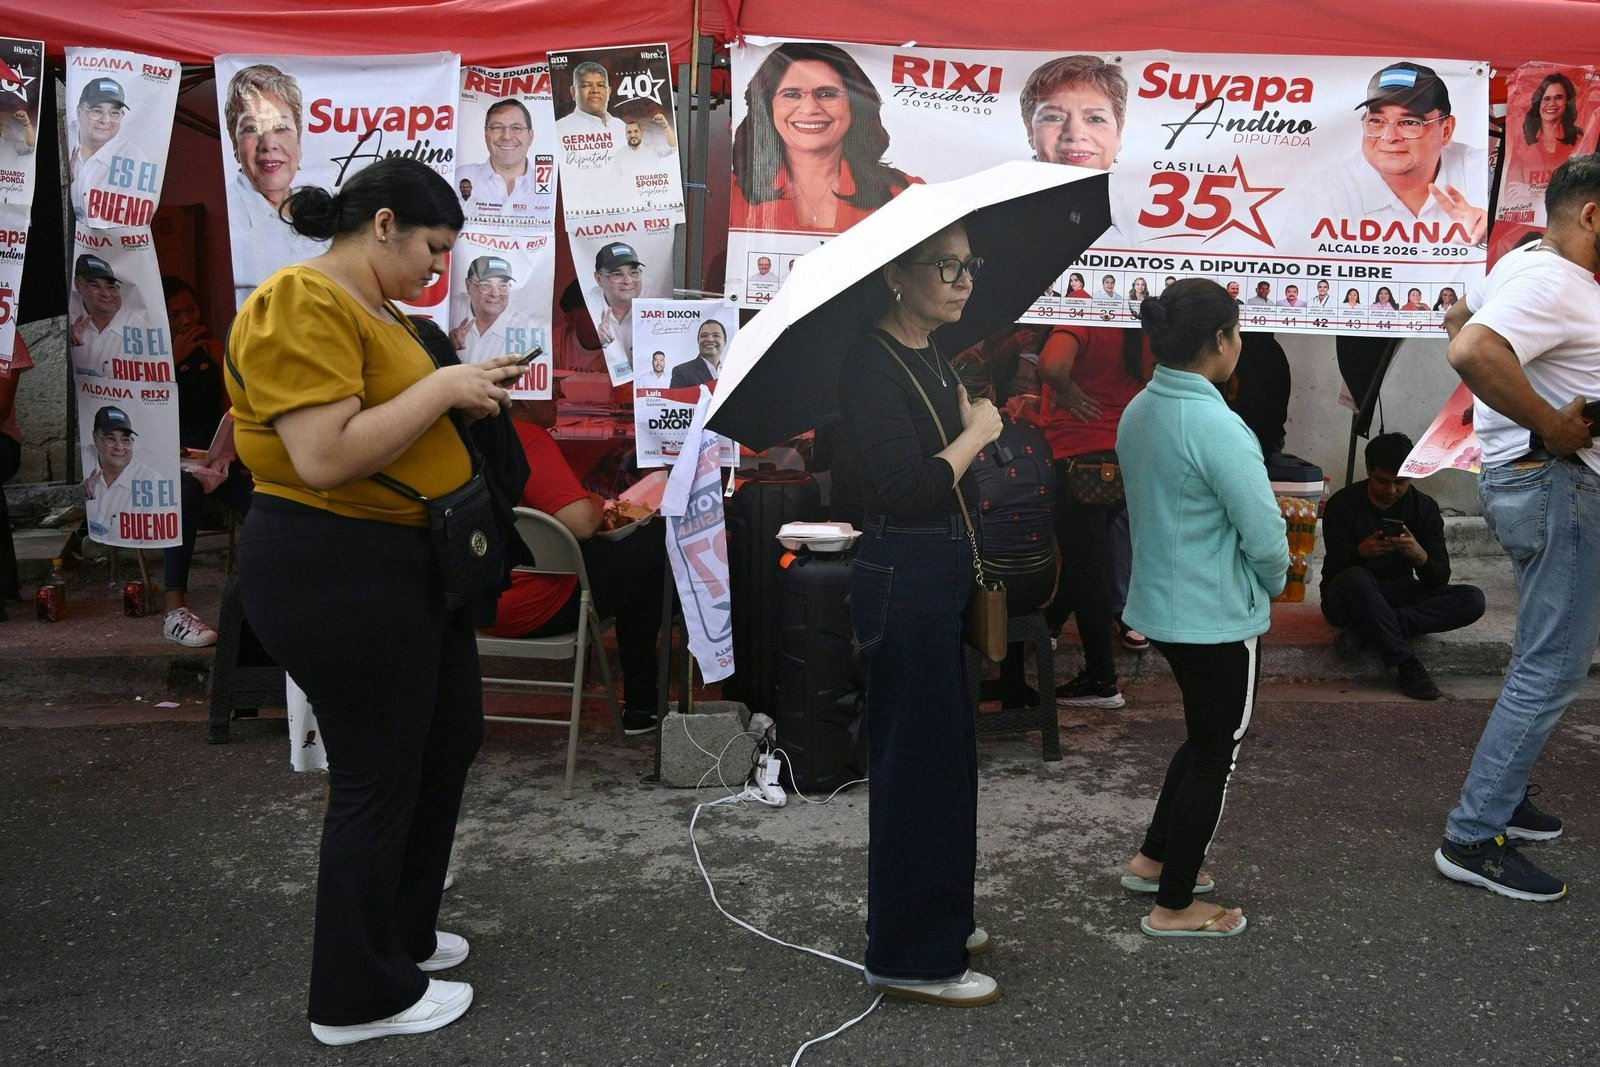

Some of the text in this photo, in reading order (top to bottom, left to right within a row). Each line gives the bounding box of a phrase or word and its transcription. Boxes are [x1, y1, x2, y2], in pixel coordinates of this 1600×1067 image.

[13, 45, 33, 54] libre
[640, 51, 658, 59] libre
[72, 56, 134, 72] ALDANA
[142, 63, 174, 80] RIXI
[550, 56, 568, 64] RIXI
[891, 54, 1004, 95] RIXI
[463, 70, 552, 98] REINA
[617, 74, 652, 99] 40
[1137, 62, 1314, 112] Suyapa
[893, 85, 999, 105] Presidenta
[902, 99, 993, 116] 2026-2030
[308, 98, 454, 141] Suyapa
[1161, 97, 1317, 150] Andino
[562, 132, 612, 144] GERMAN
[563, 141, 613, 151] VILLALOBO
[1233, 133, 1311, 148] DIPUTADA
[330, 128, 454, 187] Andino
[565, 149, 613, 168] Diputado
[0, 170, 25, 178] DUARDO
[108, 155, 158, 194] ES EL
[1153, 160, 1228, 174] CASILLA
[0, 176, 25, 185] PONDA
[536, 167, 553, 184] 27
[635, 173, 669, 182] EDUARDO
[635, 179, 669, 188] SPONDA
[1529, 170, 1552, 184] RIX
[88, 188, 155, 227] BUENO
[1137, 171, 1238, 231] 35
[575, 218, 670, 237] ALDANA RIXI
[1310, 217, 1472, 244] ALDANA
[0, 229, 26, 247] apa
[75, 231, 113, 247] DANA
[121, 233, 149, 246] RIXI
[458, 232, 520, 251] ALDANA
[526, 236, 548, 250] RIXI
[1318, 243, 1380, 254] ALCALDE
[1383, 245, 1419, 256] 2026
[1432, 246, 1469, 256] 2030
[1071, 254, 1393, 279] NDIDATOS A DIPUTADO DE LIBRE
[755, 292, 771, 303] 24
[640, 310, 700, 319] JARI DIXON
[1037, 306, 1054, 317] 33
[1069, 308, 1084, 319] 34
[1250, 315, 1267, 326] 40
[1282, 316, 1296, 327] 41
[1312, 318, 1329, 328] 42
[1345, 319, 1361, 330] 43
[1375, 320, 1391, 330] 44
[1406, 320, 1423, 331] 45
[122, 325, 169, 356] ES EL
[505, 327, 527, 356] ES
[82, 382, 134, 399] ALDANA
[141, 389, 170, 399] RIXI
[659, 408, 693, 419] JARI
[648, 418, 692, 430] DIXON
[132, 480, 178, 507] ES EL
[119, 512, 178, 540] BUENO
